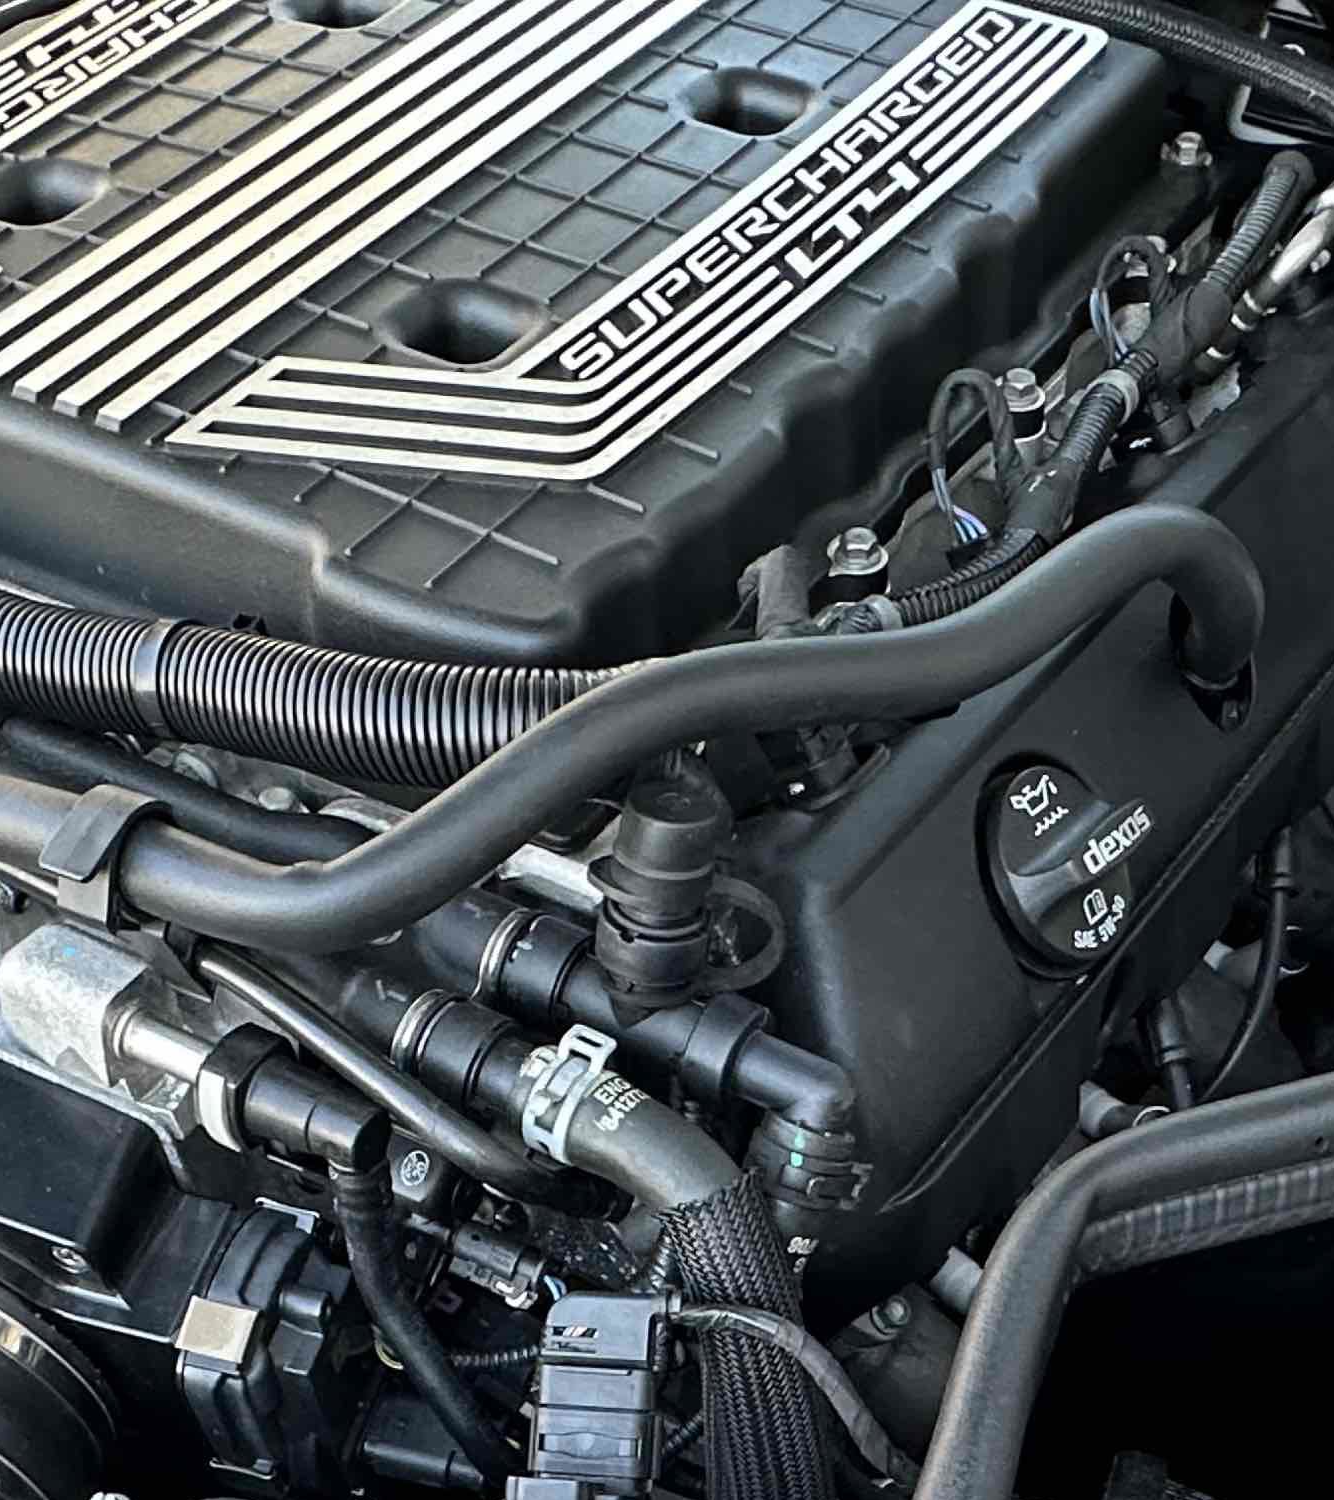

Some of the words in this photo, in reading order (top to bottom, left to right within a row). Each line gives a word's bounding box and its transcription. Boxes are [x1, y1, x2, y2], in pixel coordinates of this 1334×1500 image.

[559, 10, 1017, 379] SUPERCHARGED
[785, 159, 920, 280] LT4
[1082, 805, 1152, 875] dexos
[1074, 929, 1098, 948] SAE
